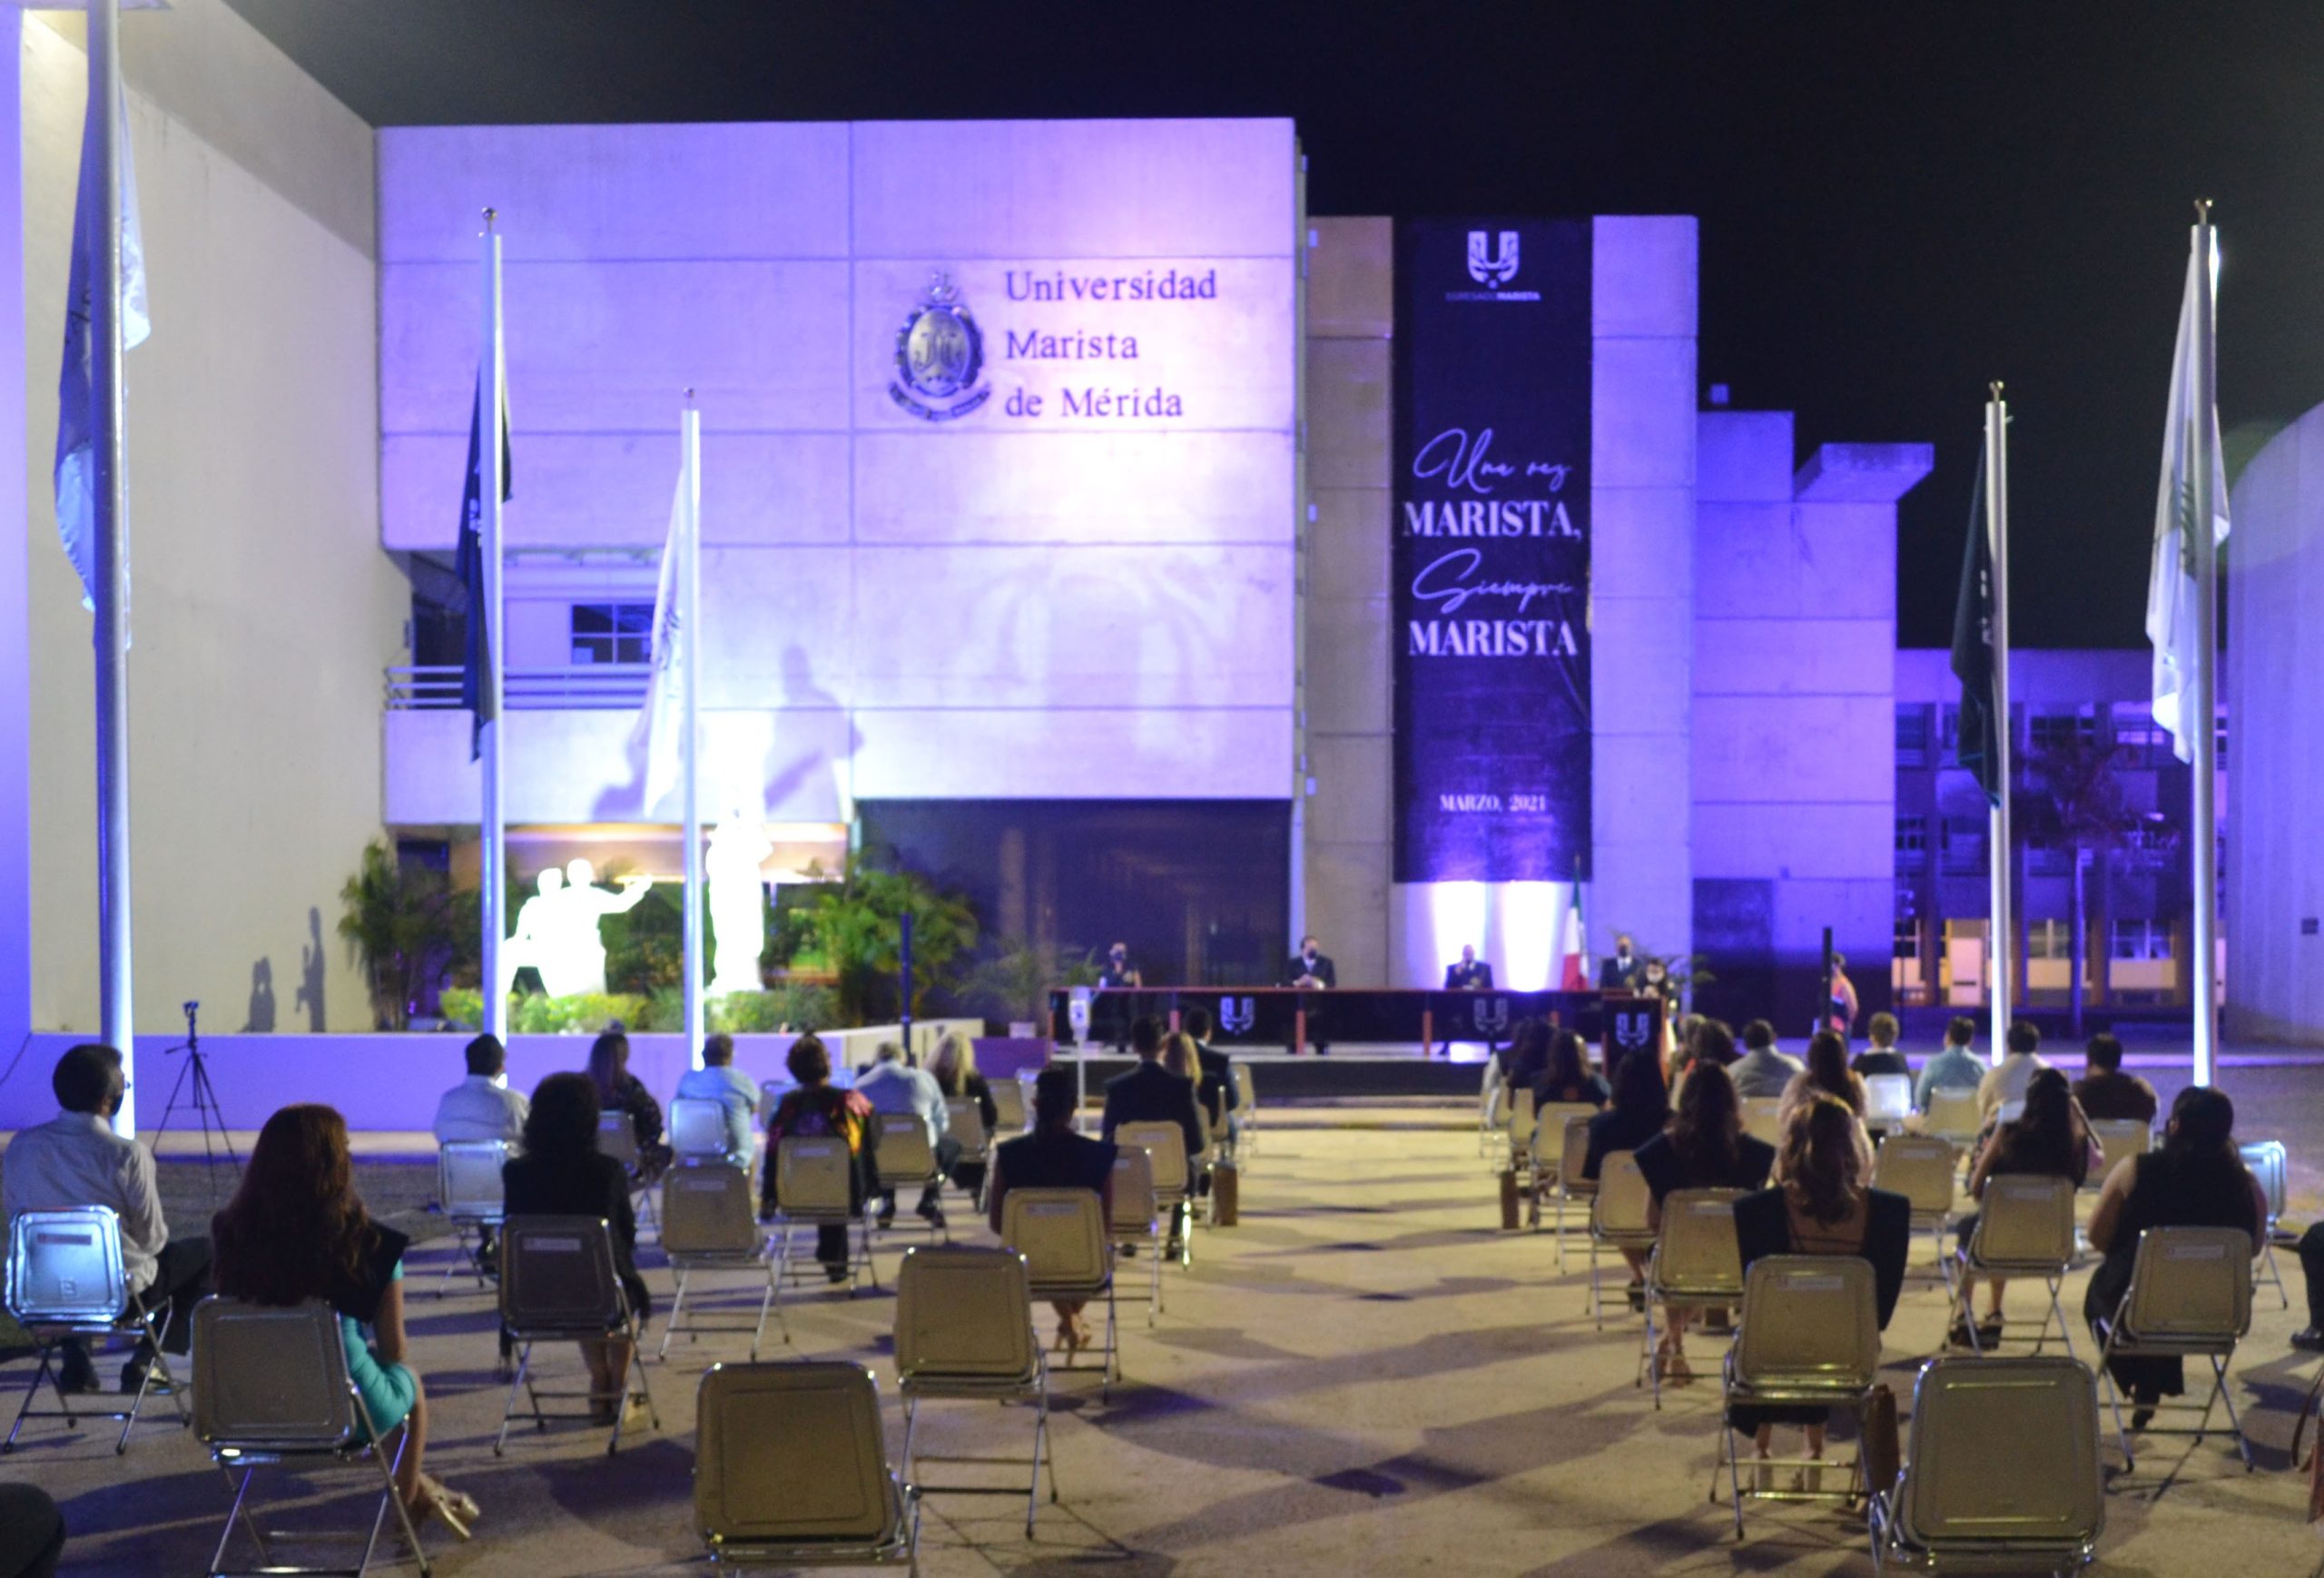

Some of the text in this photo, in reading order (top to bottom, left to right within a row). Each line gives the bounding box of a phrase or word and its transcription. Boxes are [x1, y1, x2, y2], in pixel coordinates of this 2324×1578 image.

[1005, 269, 1218, 301] Universidad
[1005, 330, 1139, 360] Marista
[1005, 387, 1044, 418] de
[1060, 387, 1184, 418] Mérida
[1403, 500, 1582, 542] MARISTA,
[1407, 620, 1579, 656] MARISTA
[1509, 794, 1546, 813] 2021
